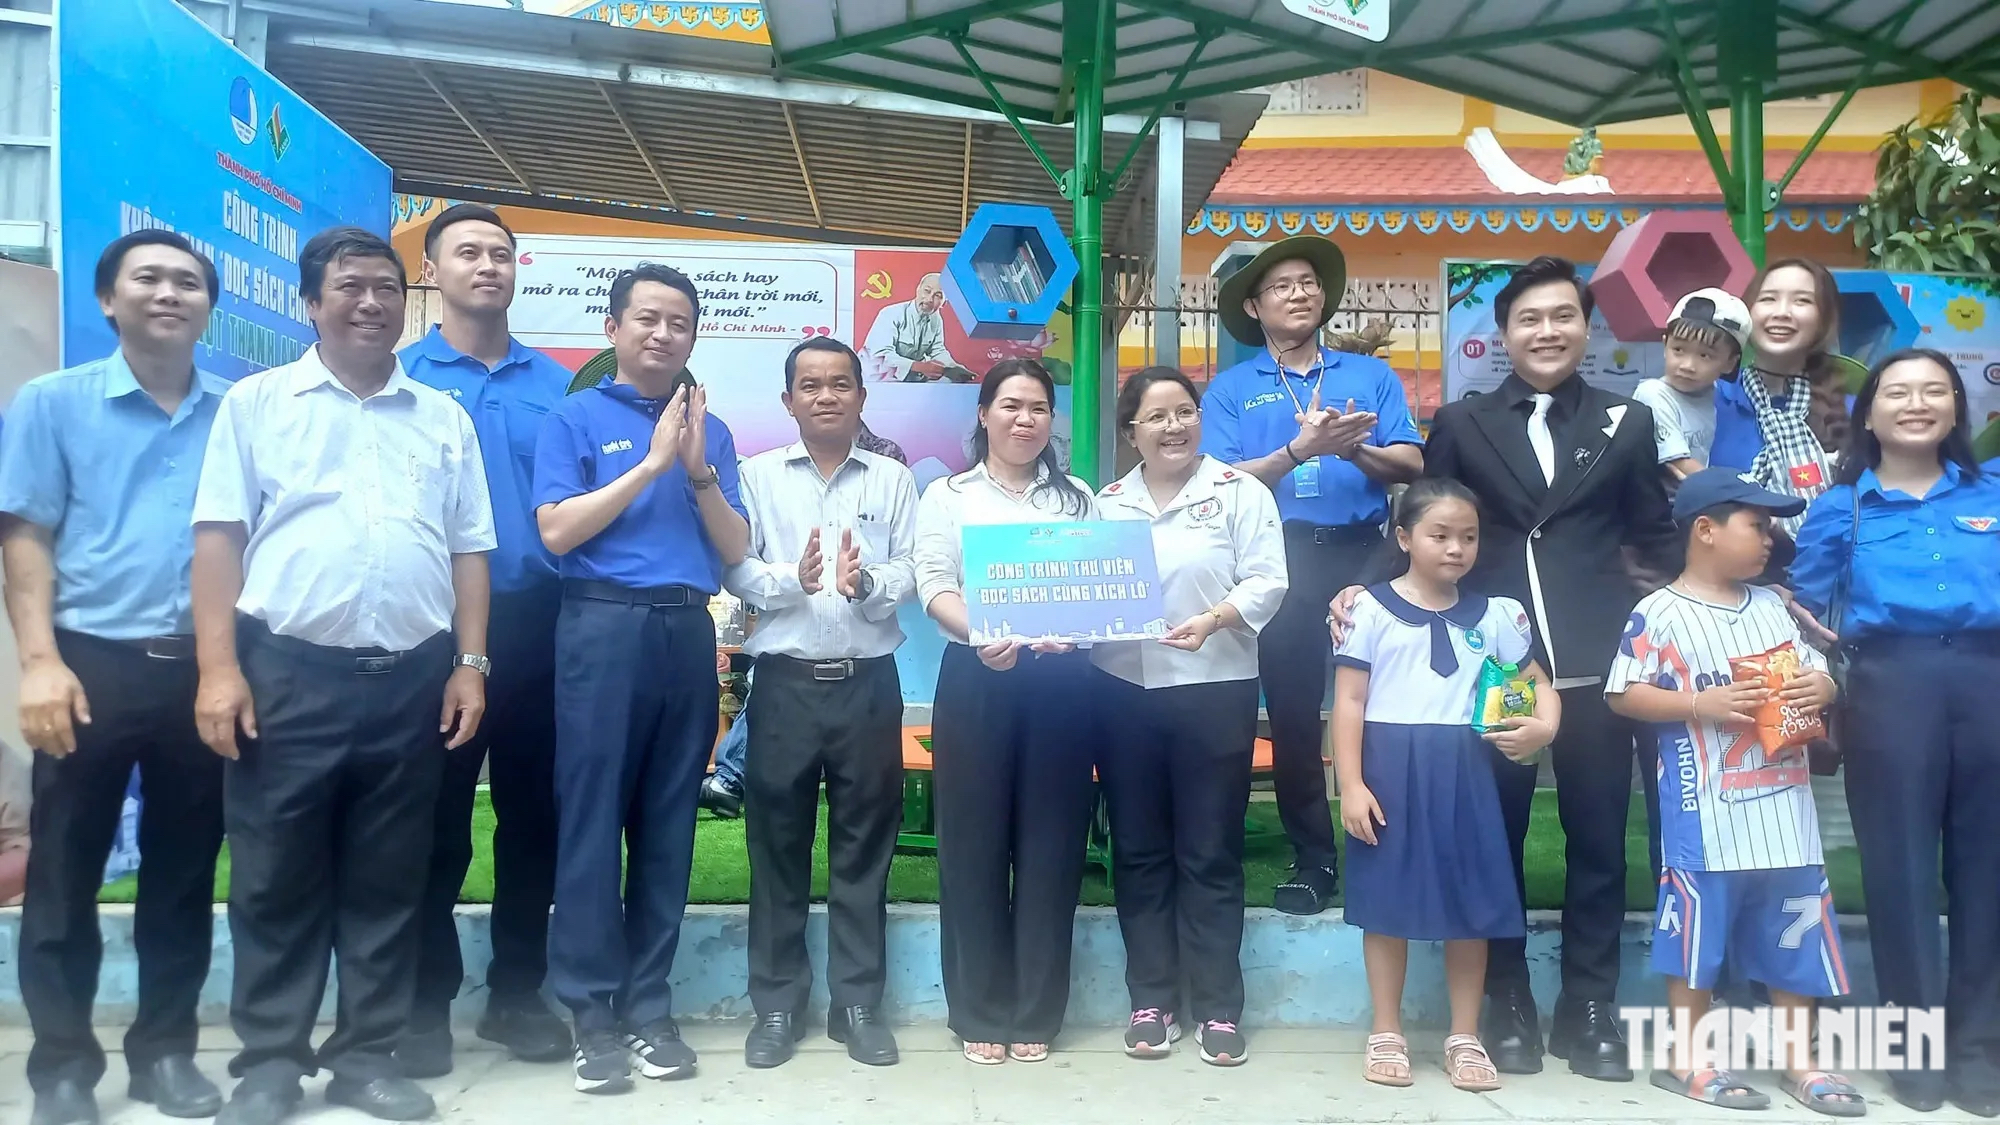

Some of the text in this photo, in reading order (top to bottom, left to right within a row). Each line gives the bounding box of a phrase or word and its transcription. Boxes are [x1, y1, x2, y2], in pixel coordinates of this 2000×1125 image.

[217, 151, 303, 214] THÀNH PHỐ HỒ CHÍ MINH
[223, 190, 259, 245] CÔNG
[262, 212, 297, 264] TRÌNH
[694, 271, 738, 282] sách
[743, 272, 779, 285] hay
[253, 266, 286, 315] SÁCH
[522, 284, 554, 296] mở
[557, 286, 580, 296] ra
[696, 289, 741, 300] chân
[745, 290, 779, 301] trời
[783, 290, 824, 304] mới,
[723, 323, 747, 333] Chí
[750, 324, 786, 333] Minh
[1466, 342, 1481, 355] 01
[987, 562, 1025, 580] CÔNG
[1073, 559, 1100, 577] THƯ
[1102, 556, 1136, 579] VIỆN
[1011, 584, 1049, 605] SÁCH
[1052, 582, 1092, 603] CÙNG
[1094, 581, 1127, 601] XÍCH
[1675, 737, 1698, 813] BIVOHN
[1778, 894, 1822, 950] 7
